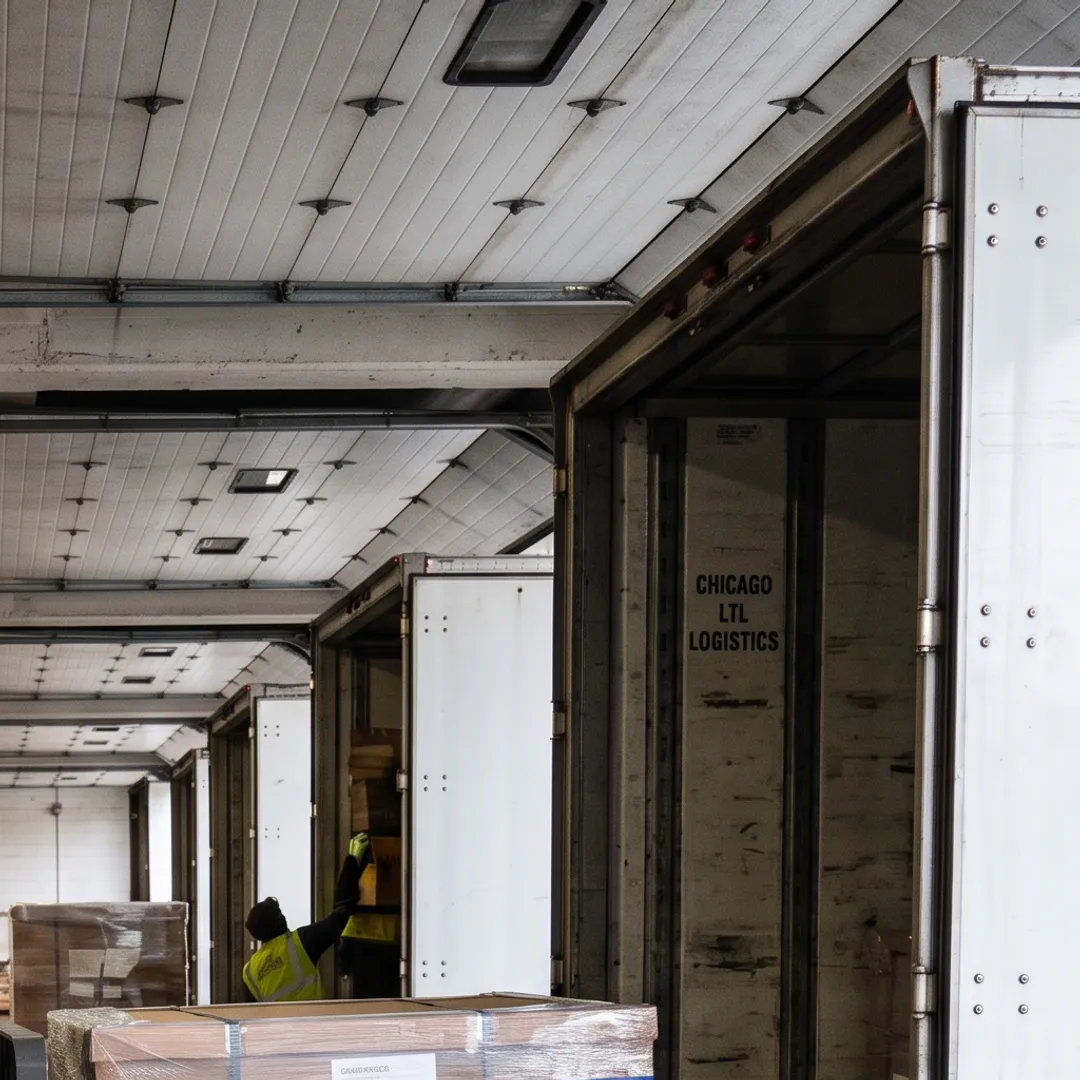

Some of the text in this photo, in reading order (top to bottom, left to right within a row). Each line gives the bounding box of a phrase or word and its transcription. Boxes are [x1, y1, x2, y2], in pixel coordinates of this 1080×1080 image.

[696, 574, 773, 595] CHICAGO
[719, 603, 749, 623] LTL
[689, 631, 780, 651] LOGISTICS
